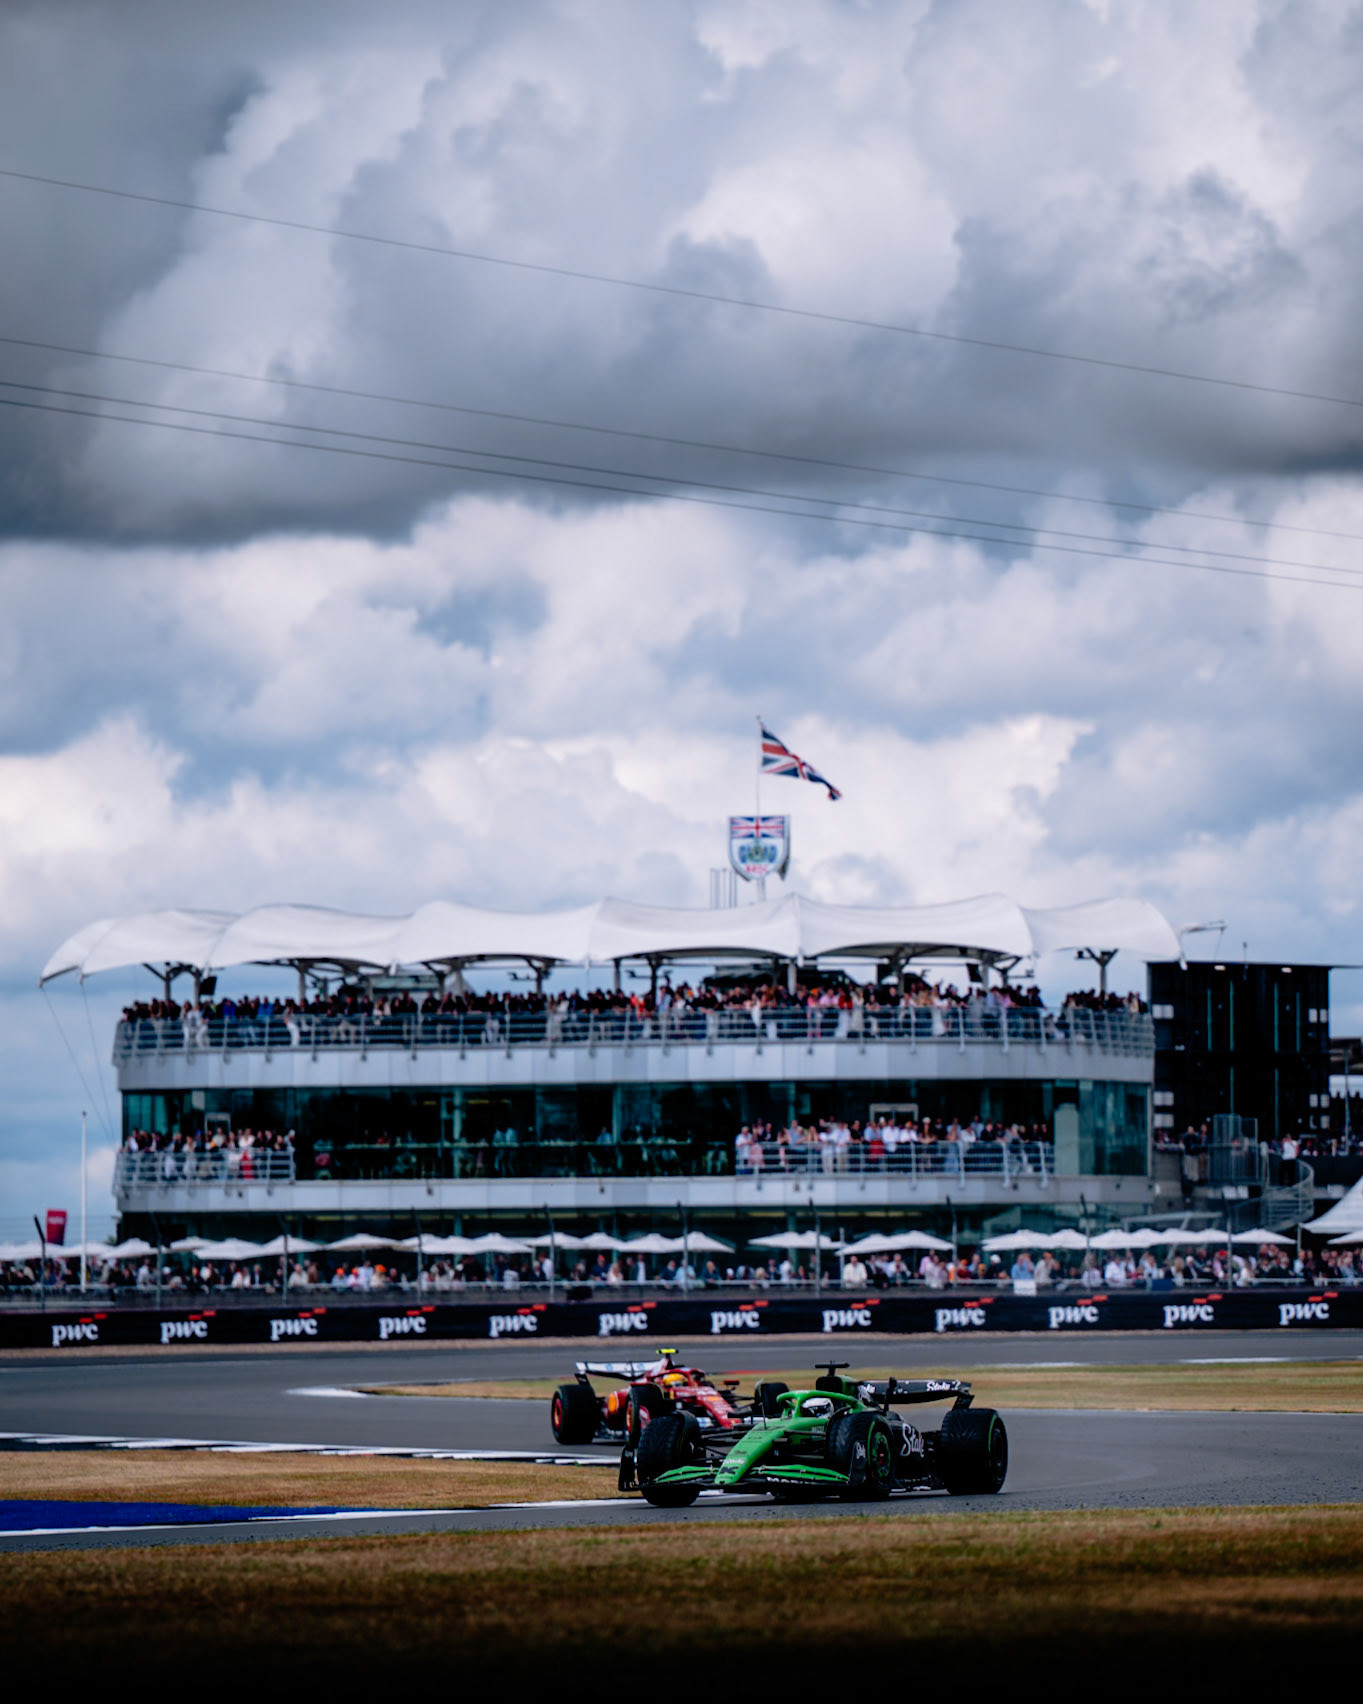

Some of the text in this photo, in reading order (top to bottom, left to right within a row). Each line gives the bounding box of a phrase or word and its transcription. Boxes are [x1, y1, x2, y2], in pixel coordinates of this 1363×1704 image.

[489, 1314, 537, 1337] pwc
[599, 1311, 648, 1336] pwc
[710, 1311, 760, 1334] pwc
[823, 1308, 872, 1333] pwc
[935, 1307, 986, 1332] pwc
[1049, 1305, 1099, 1328] pwc
[1163, 1304, 1214, 1328] pwc
[1279, 1302, 1330, 1326] pwc
[52, 1324, 99, 1346] pwc
[161, 1321, 208, 1344] pwc
[270, 1318, 318, 1341] pwc
[379, 1316, 427, 1339] pwc
